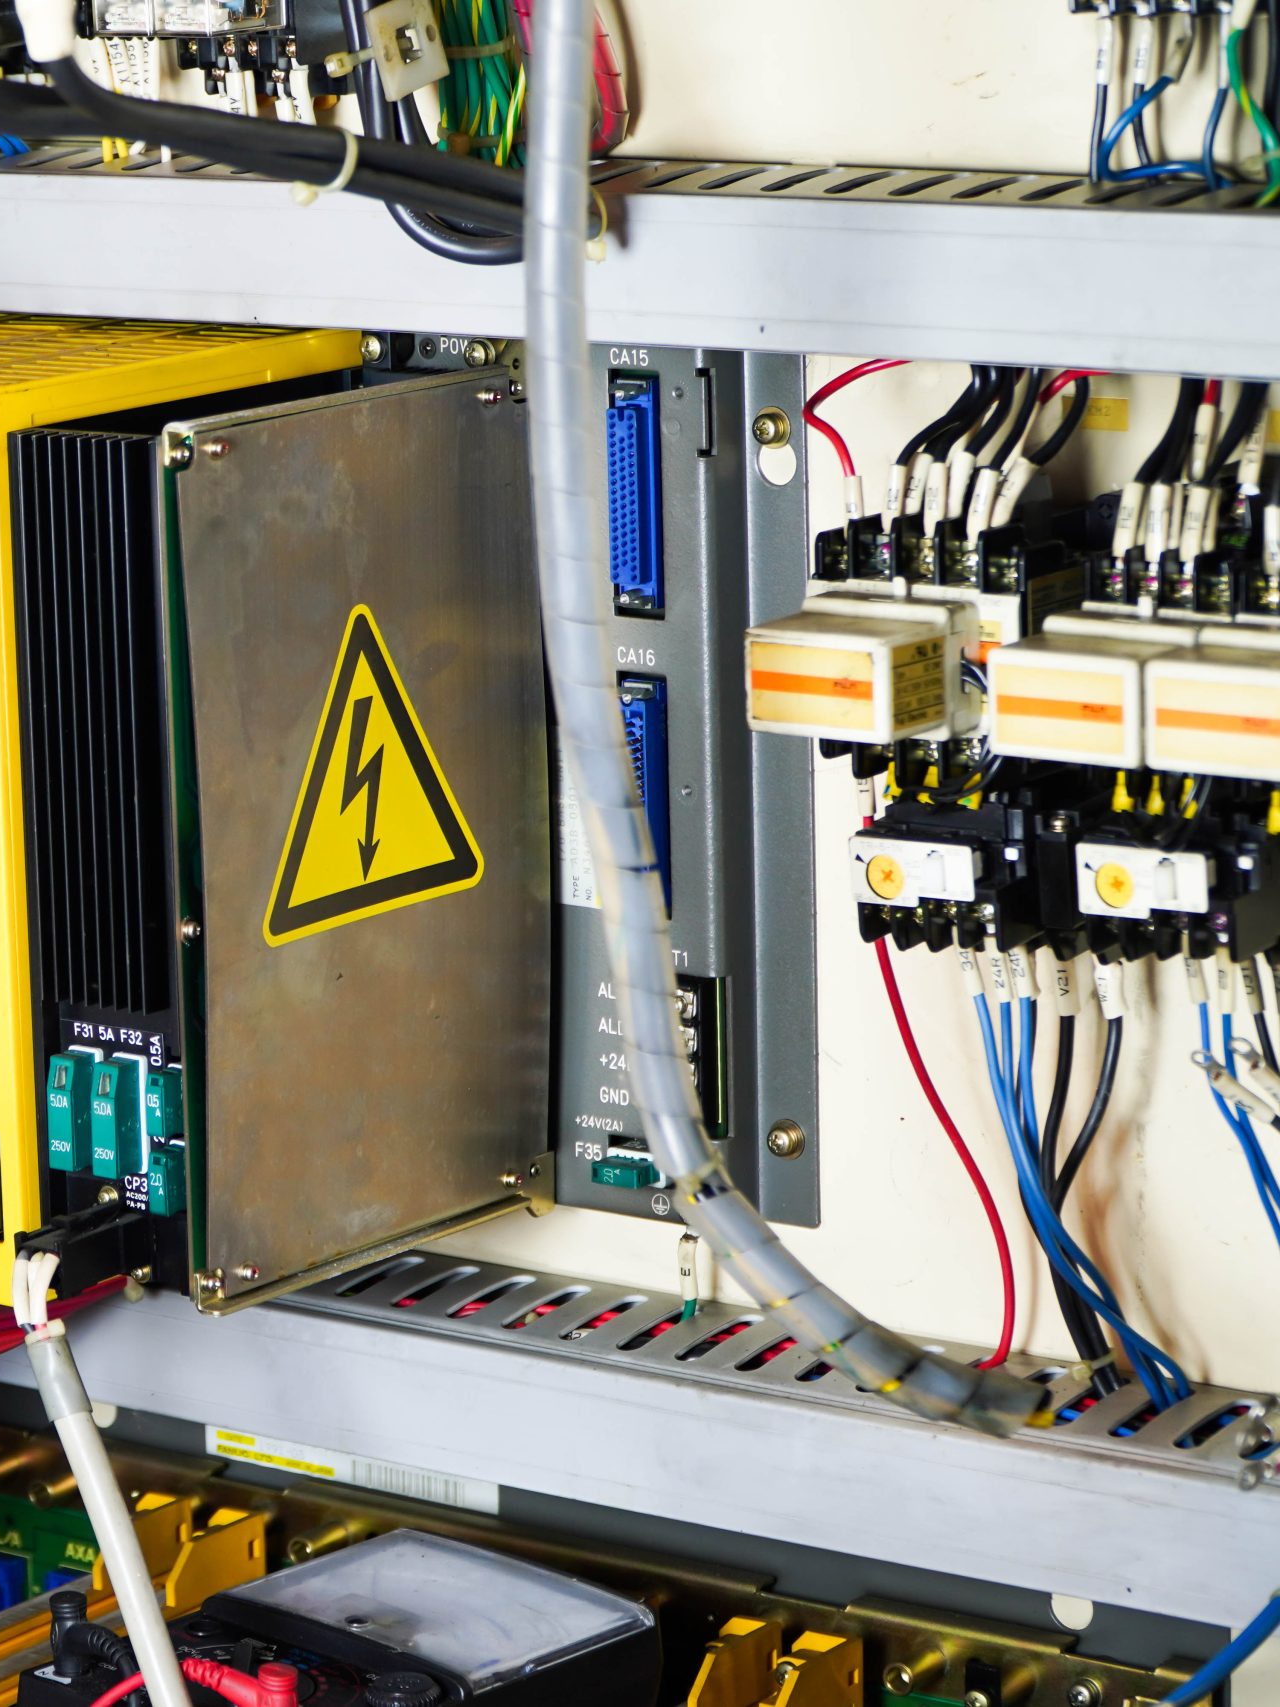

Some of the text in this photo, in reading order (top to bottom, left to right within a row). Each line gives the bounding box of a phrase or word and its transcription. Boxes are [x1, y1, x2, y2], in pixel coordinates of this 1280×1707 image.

[609, 348, 649, 367] CA15
[617, 646, 656, 666] CA16
[572, 875, 580, 898] TYPE
[671, 949, 689, 967] T1
[73, 1022, 143, 1046] F31 5A F32
[599, 1053, 631, 1072] +24
[599, 1086, 630, 1107] GND
[155, 1108, 161, 1118] A
[574, 1116, 623, 1132] +24V(2A)
[50, 1139, 71, 1153] 250V
[94, 1147, 114, 1160] 250V
[575, 1142, 603, 1161] F35
[124, 1175, 148, 1193] CP3
[158, 1187, 164, 1196] A
[680, 1267, 691, 1276] E
